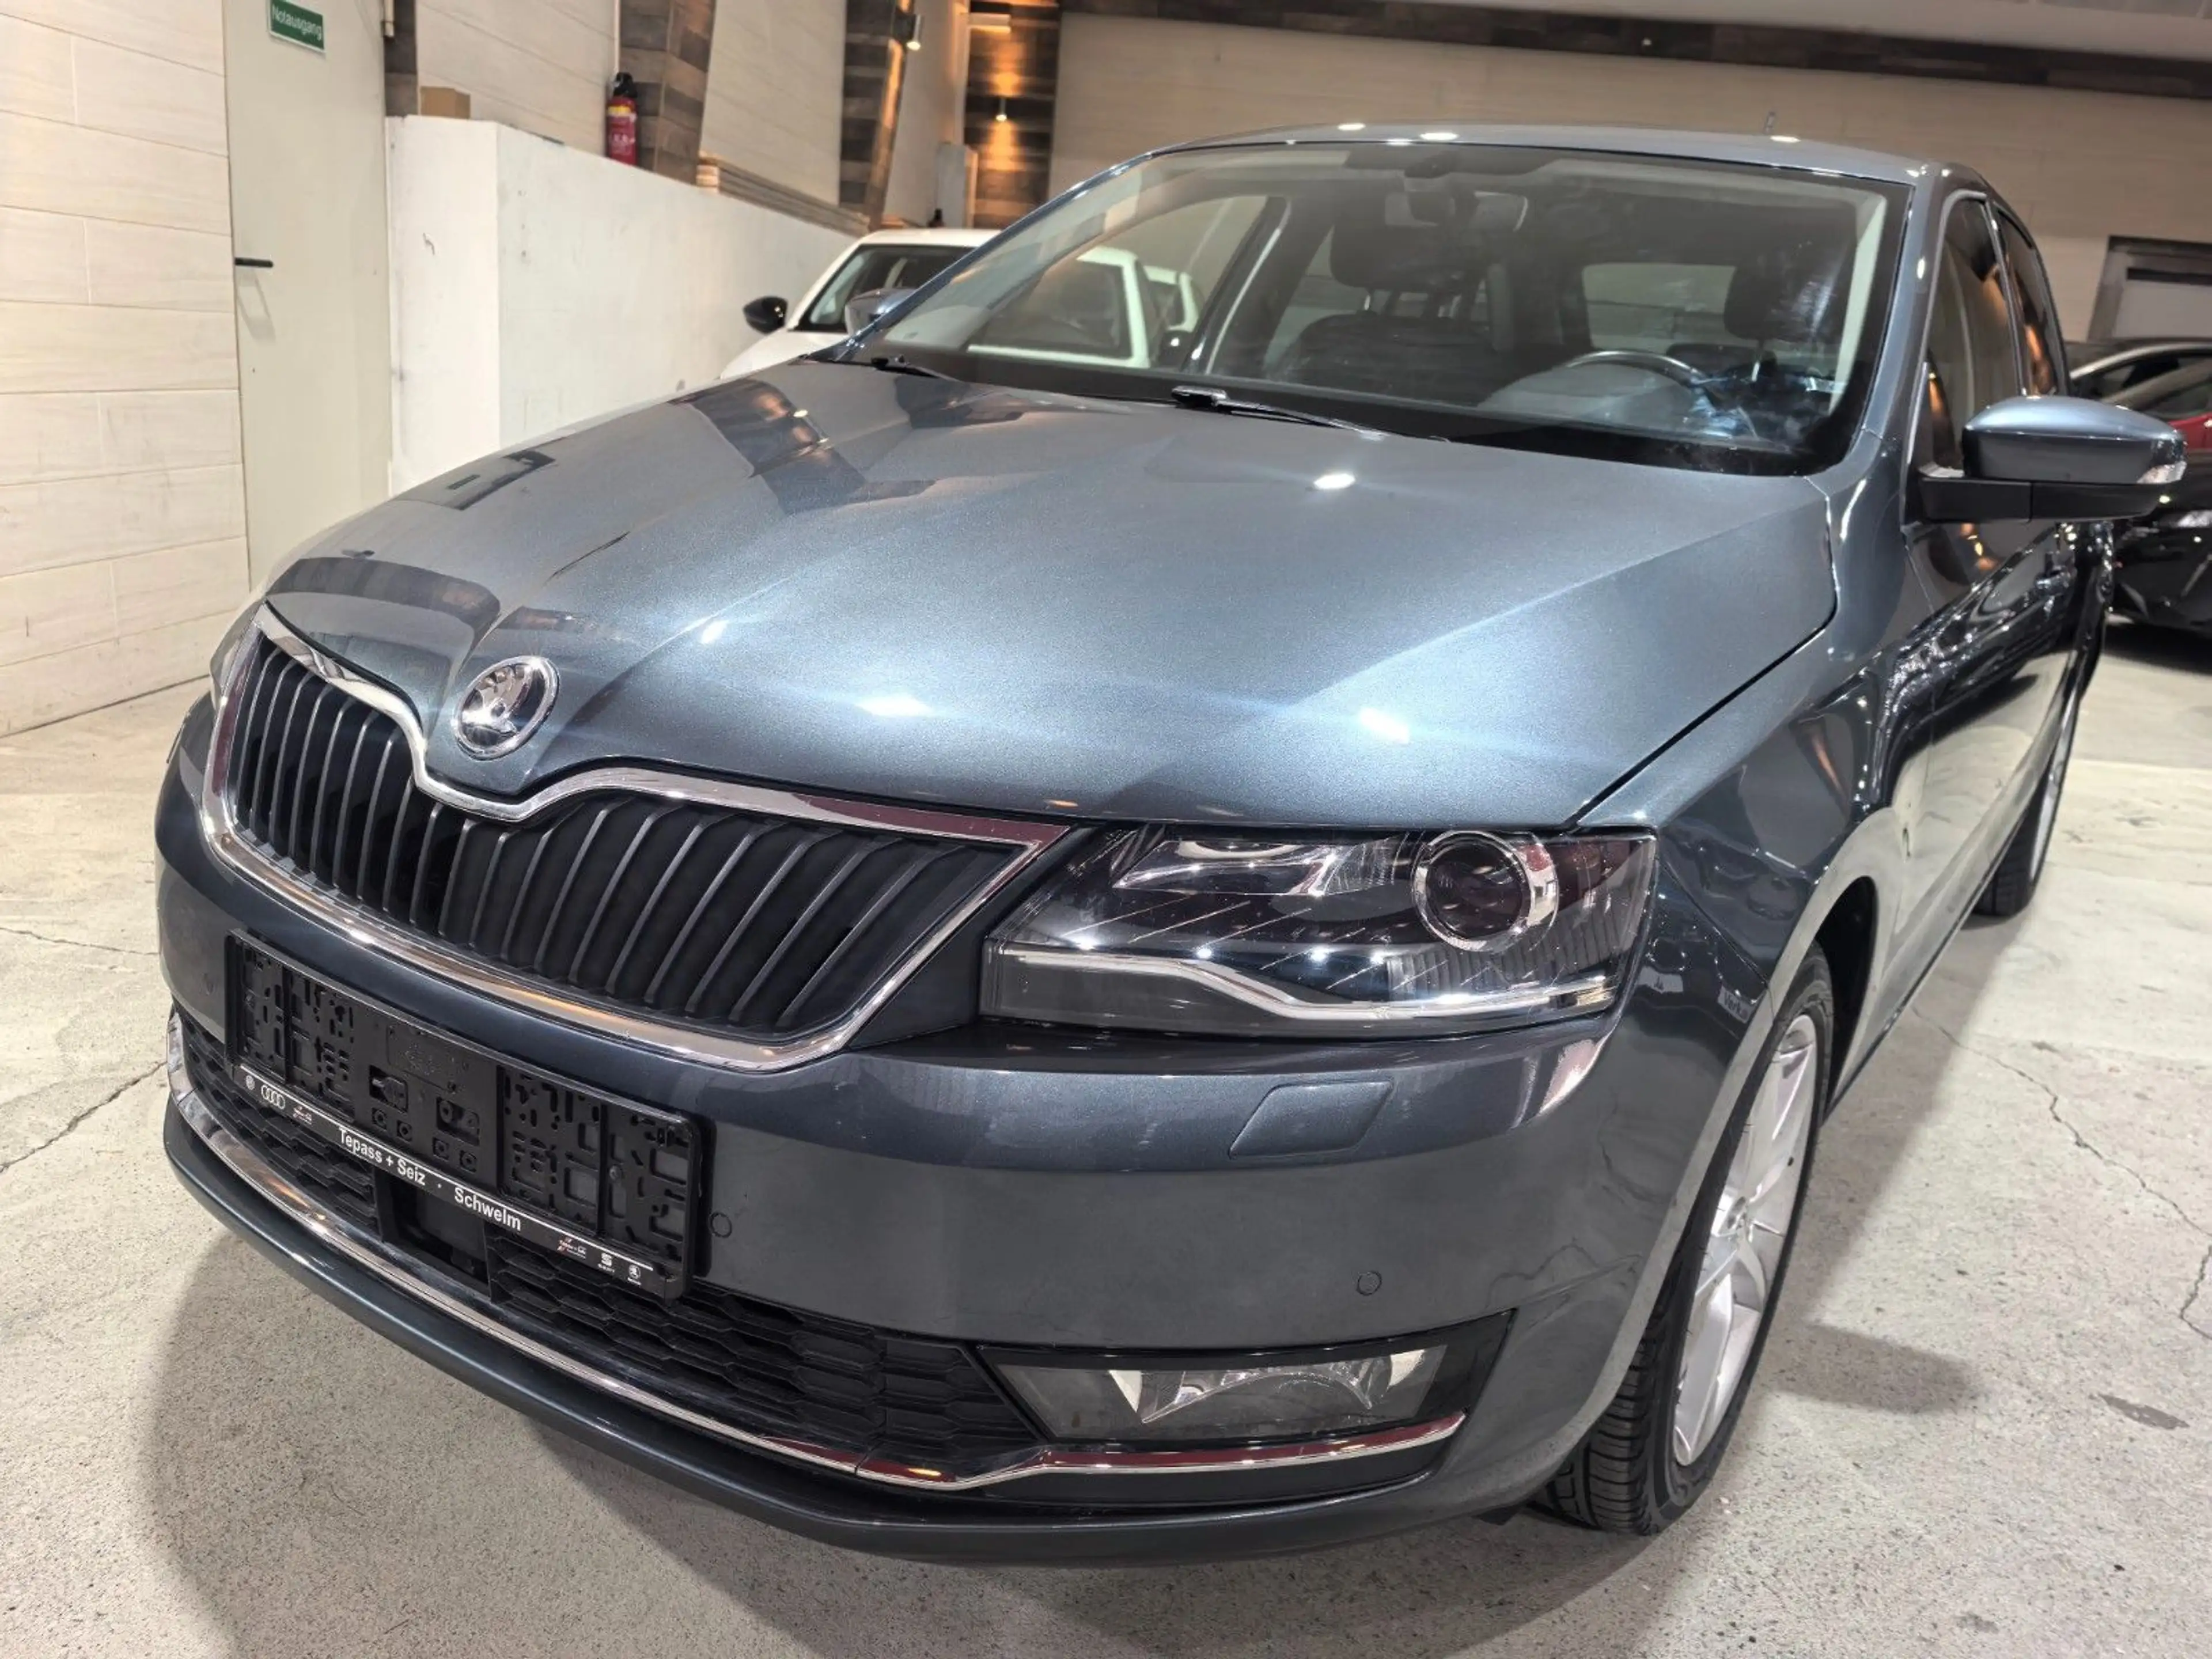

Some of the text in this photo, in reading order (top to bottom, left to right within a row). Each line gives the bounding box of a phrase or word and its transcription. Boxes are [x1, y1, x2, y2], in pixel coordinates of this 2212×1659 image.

[339, 1126, 382, 1164] Tepass
[397, 1158, 426, 1186] Seiz
[454, 1186, 521, 1231] Schwelm
